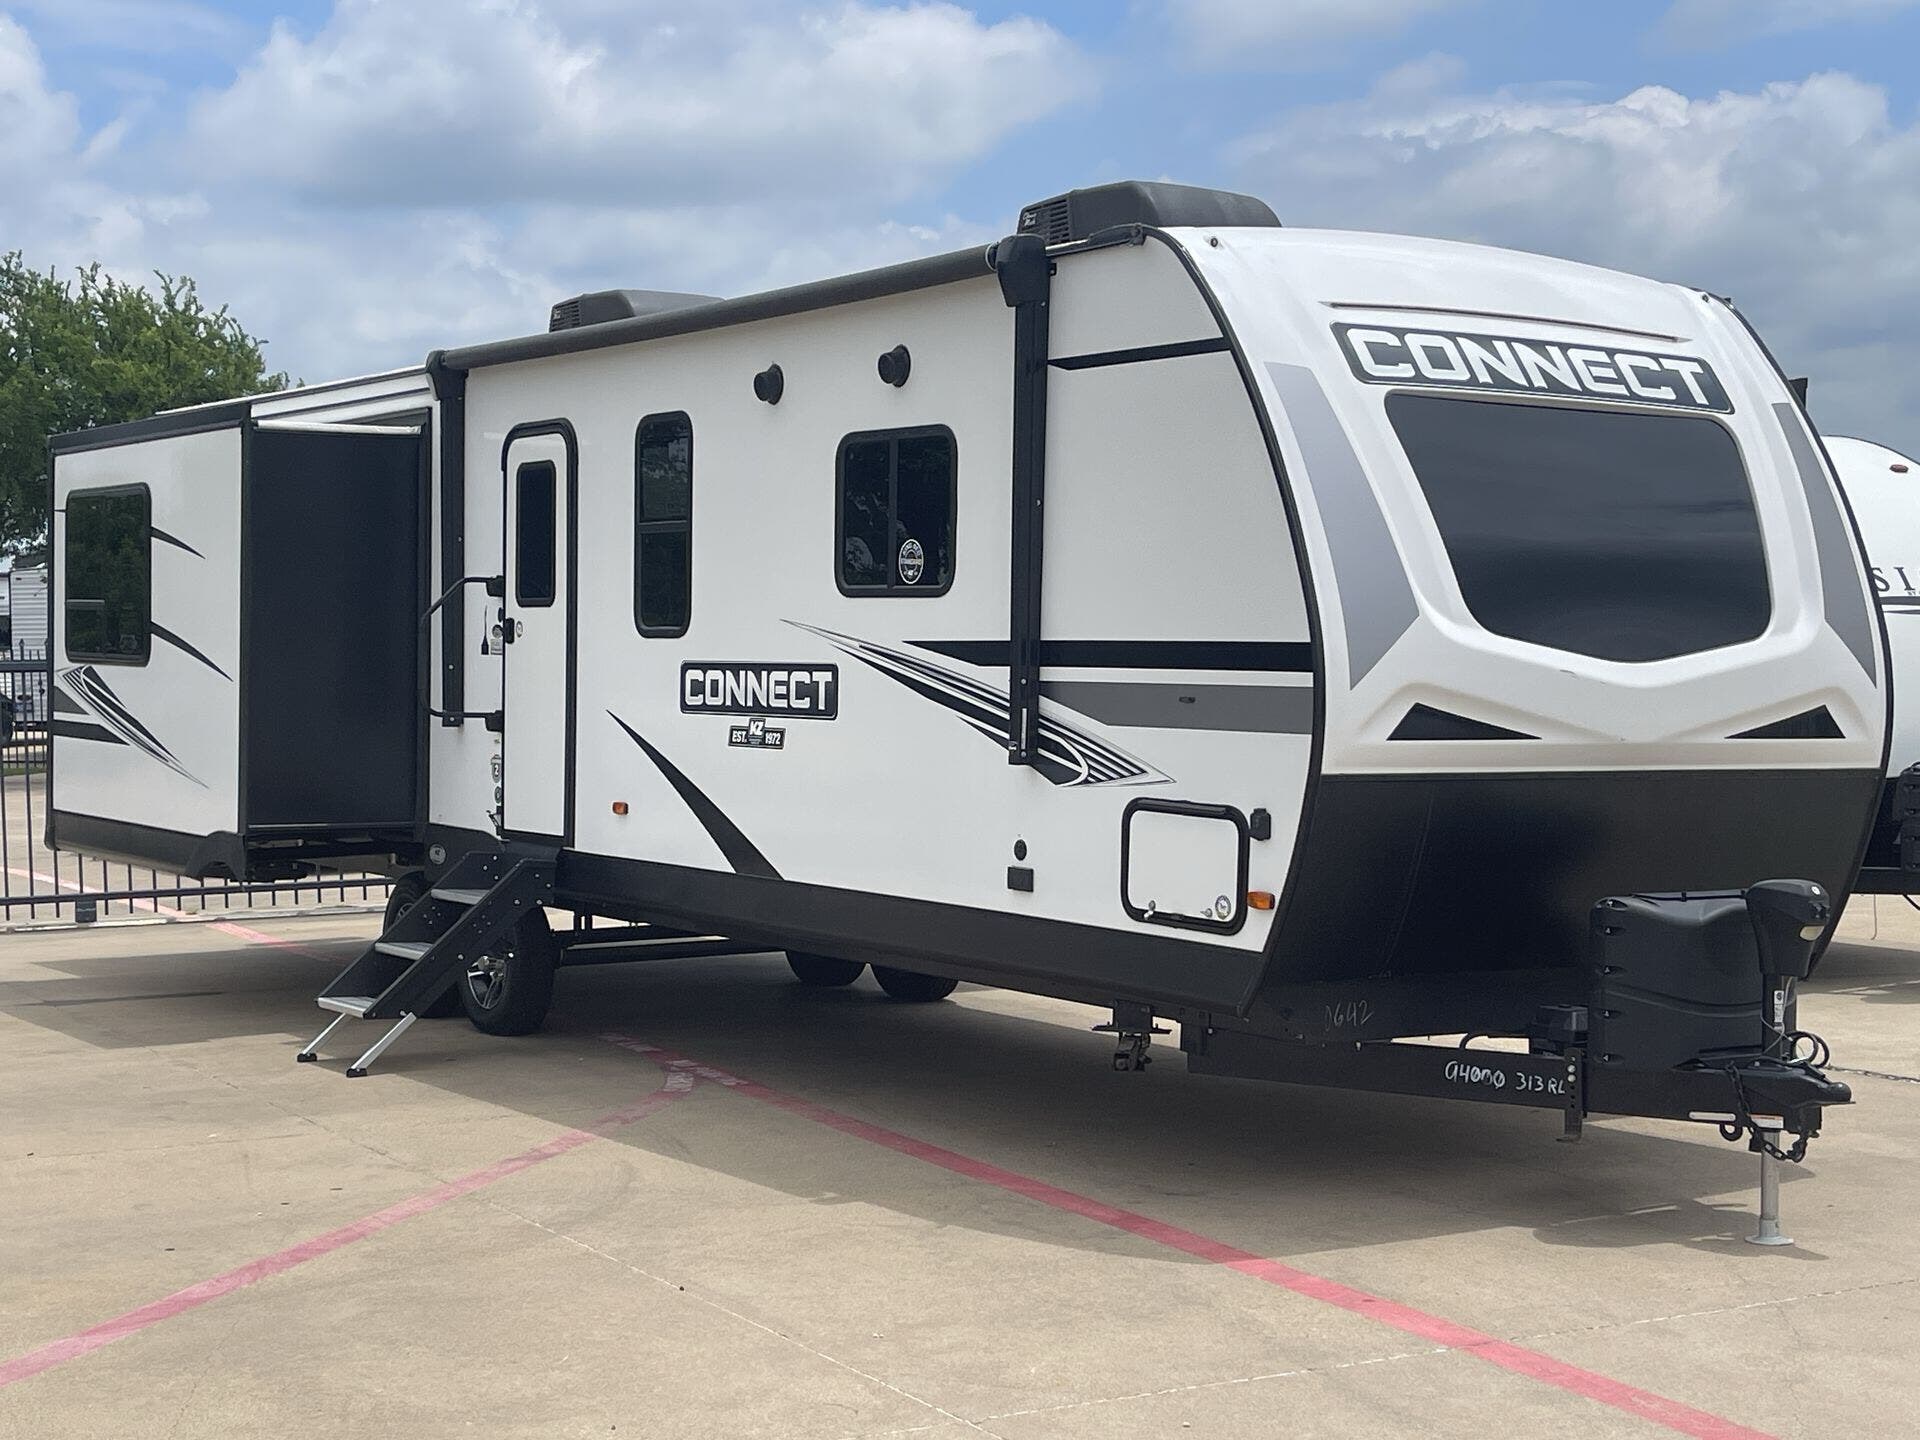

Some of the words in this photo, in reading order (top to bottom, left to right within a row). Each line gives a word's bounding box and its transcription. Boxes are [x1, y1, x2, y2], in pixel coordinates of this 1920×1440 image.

[1346, 328, 1710, 405] CONNECT
[685, 670, 832, 710] CONNECT
[732, 730, 748, 743] EST.
[765, 732, 781, 745] 1972
[749, 721, 764, 735] KZ
